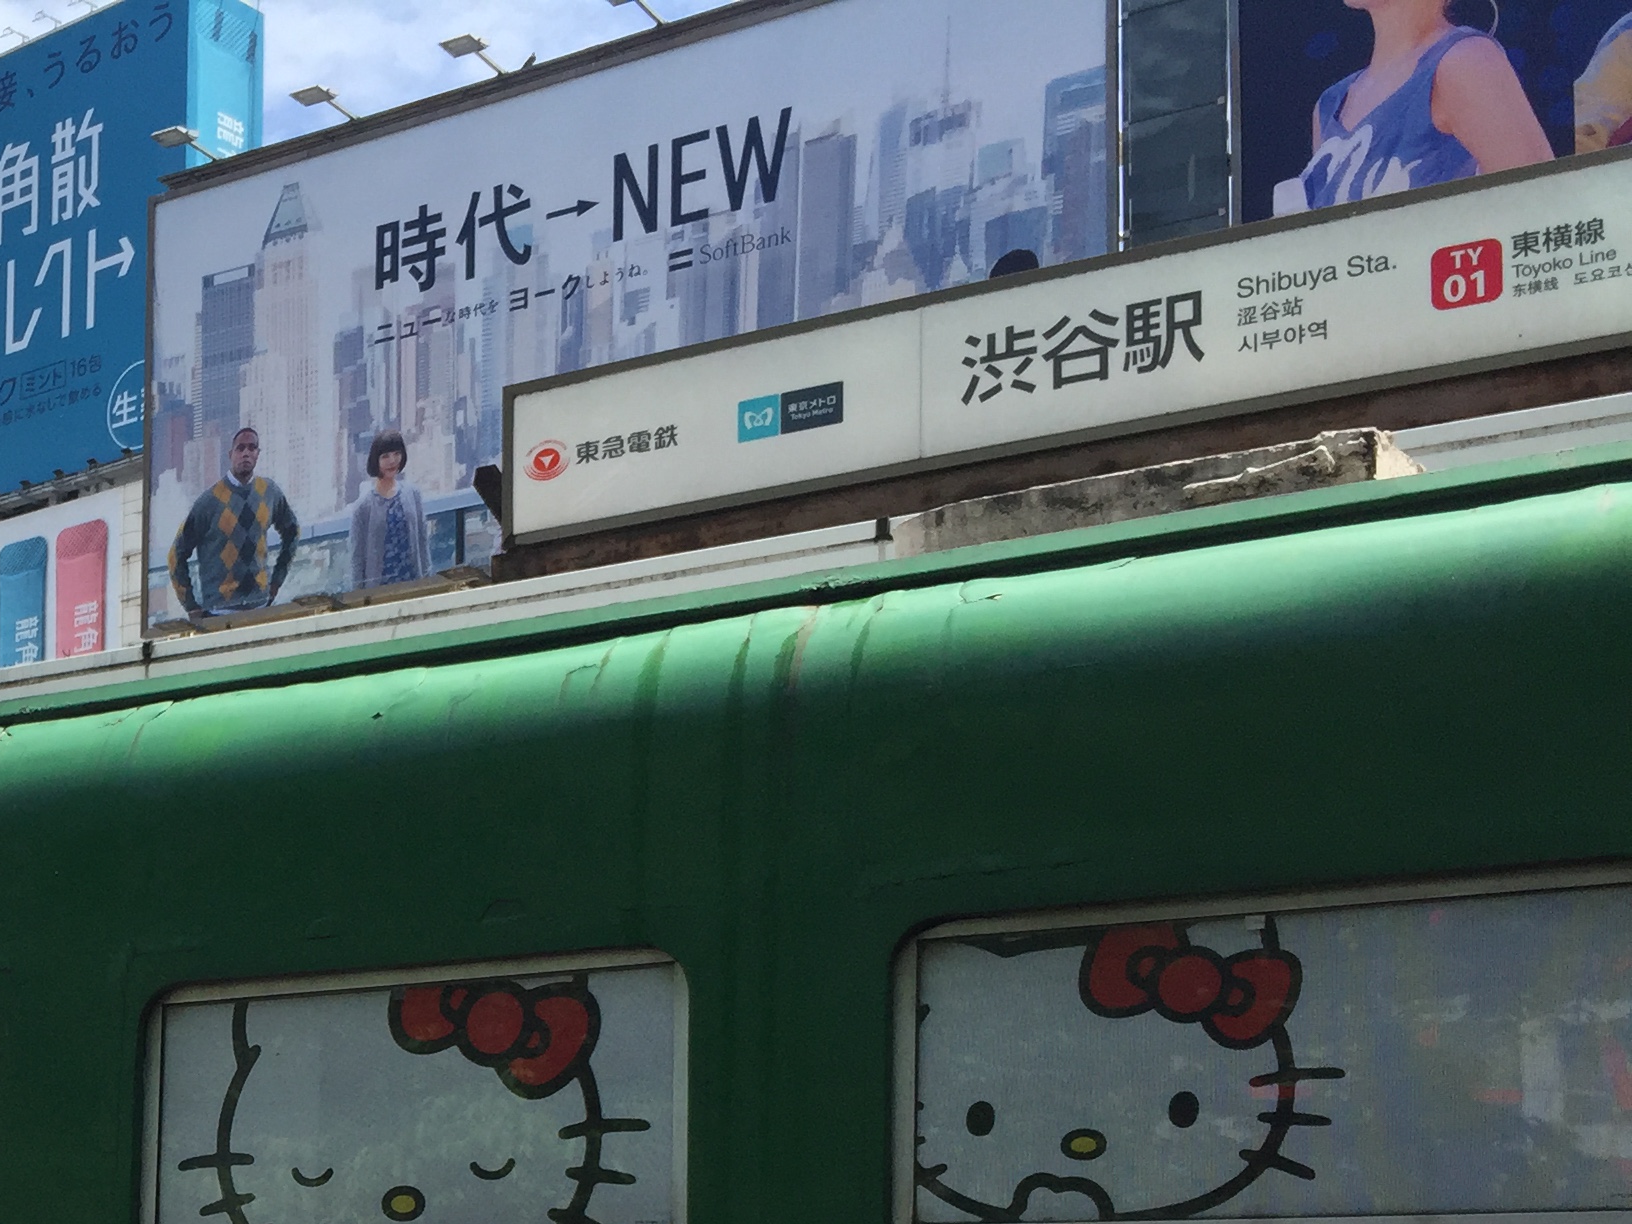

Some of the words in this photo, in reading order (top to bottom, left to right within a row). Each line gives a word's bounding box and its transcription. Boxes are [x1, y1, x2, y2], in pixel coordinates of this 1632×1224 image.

[374, 184, 532, 292] 時代
[612, 106, 792, 241] NEW
[699, 227, 792, 264] SoftBank
[1511, 217, 1606, 259] 東横線
[1450, 246, 1483, 269] TY
[1579, 248, 1617, 266] Line
[1237, 265, 1338, 298] Shibuya
[1346, 254, 1397, 278] Sta.
[1443, 269, 1485, 303] 01
[1512, 277, 1559, 297] 东横线
[1237, 296, 1304, 327] 涩谷站
[961, 290, 1205, 406] 渋谷駅
[1237, 319, 1328, 352] 시부야역
[26, 368, 61, 392] ミント
[788, 395, 836, 413] 東京メトロ
[575, 424, 679, 465] 東急電鉄
